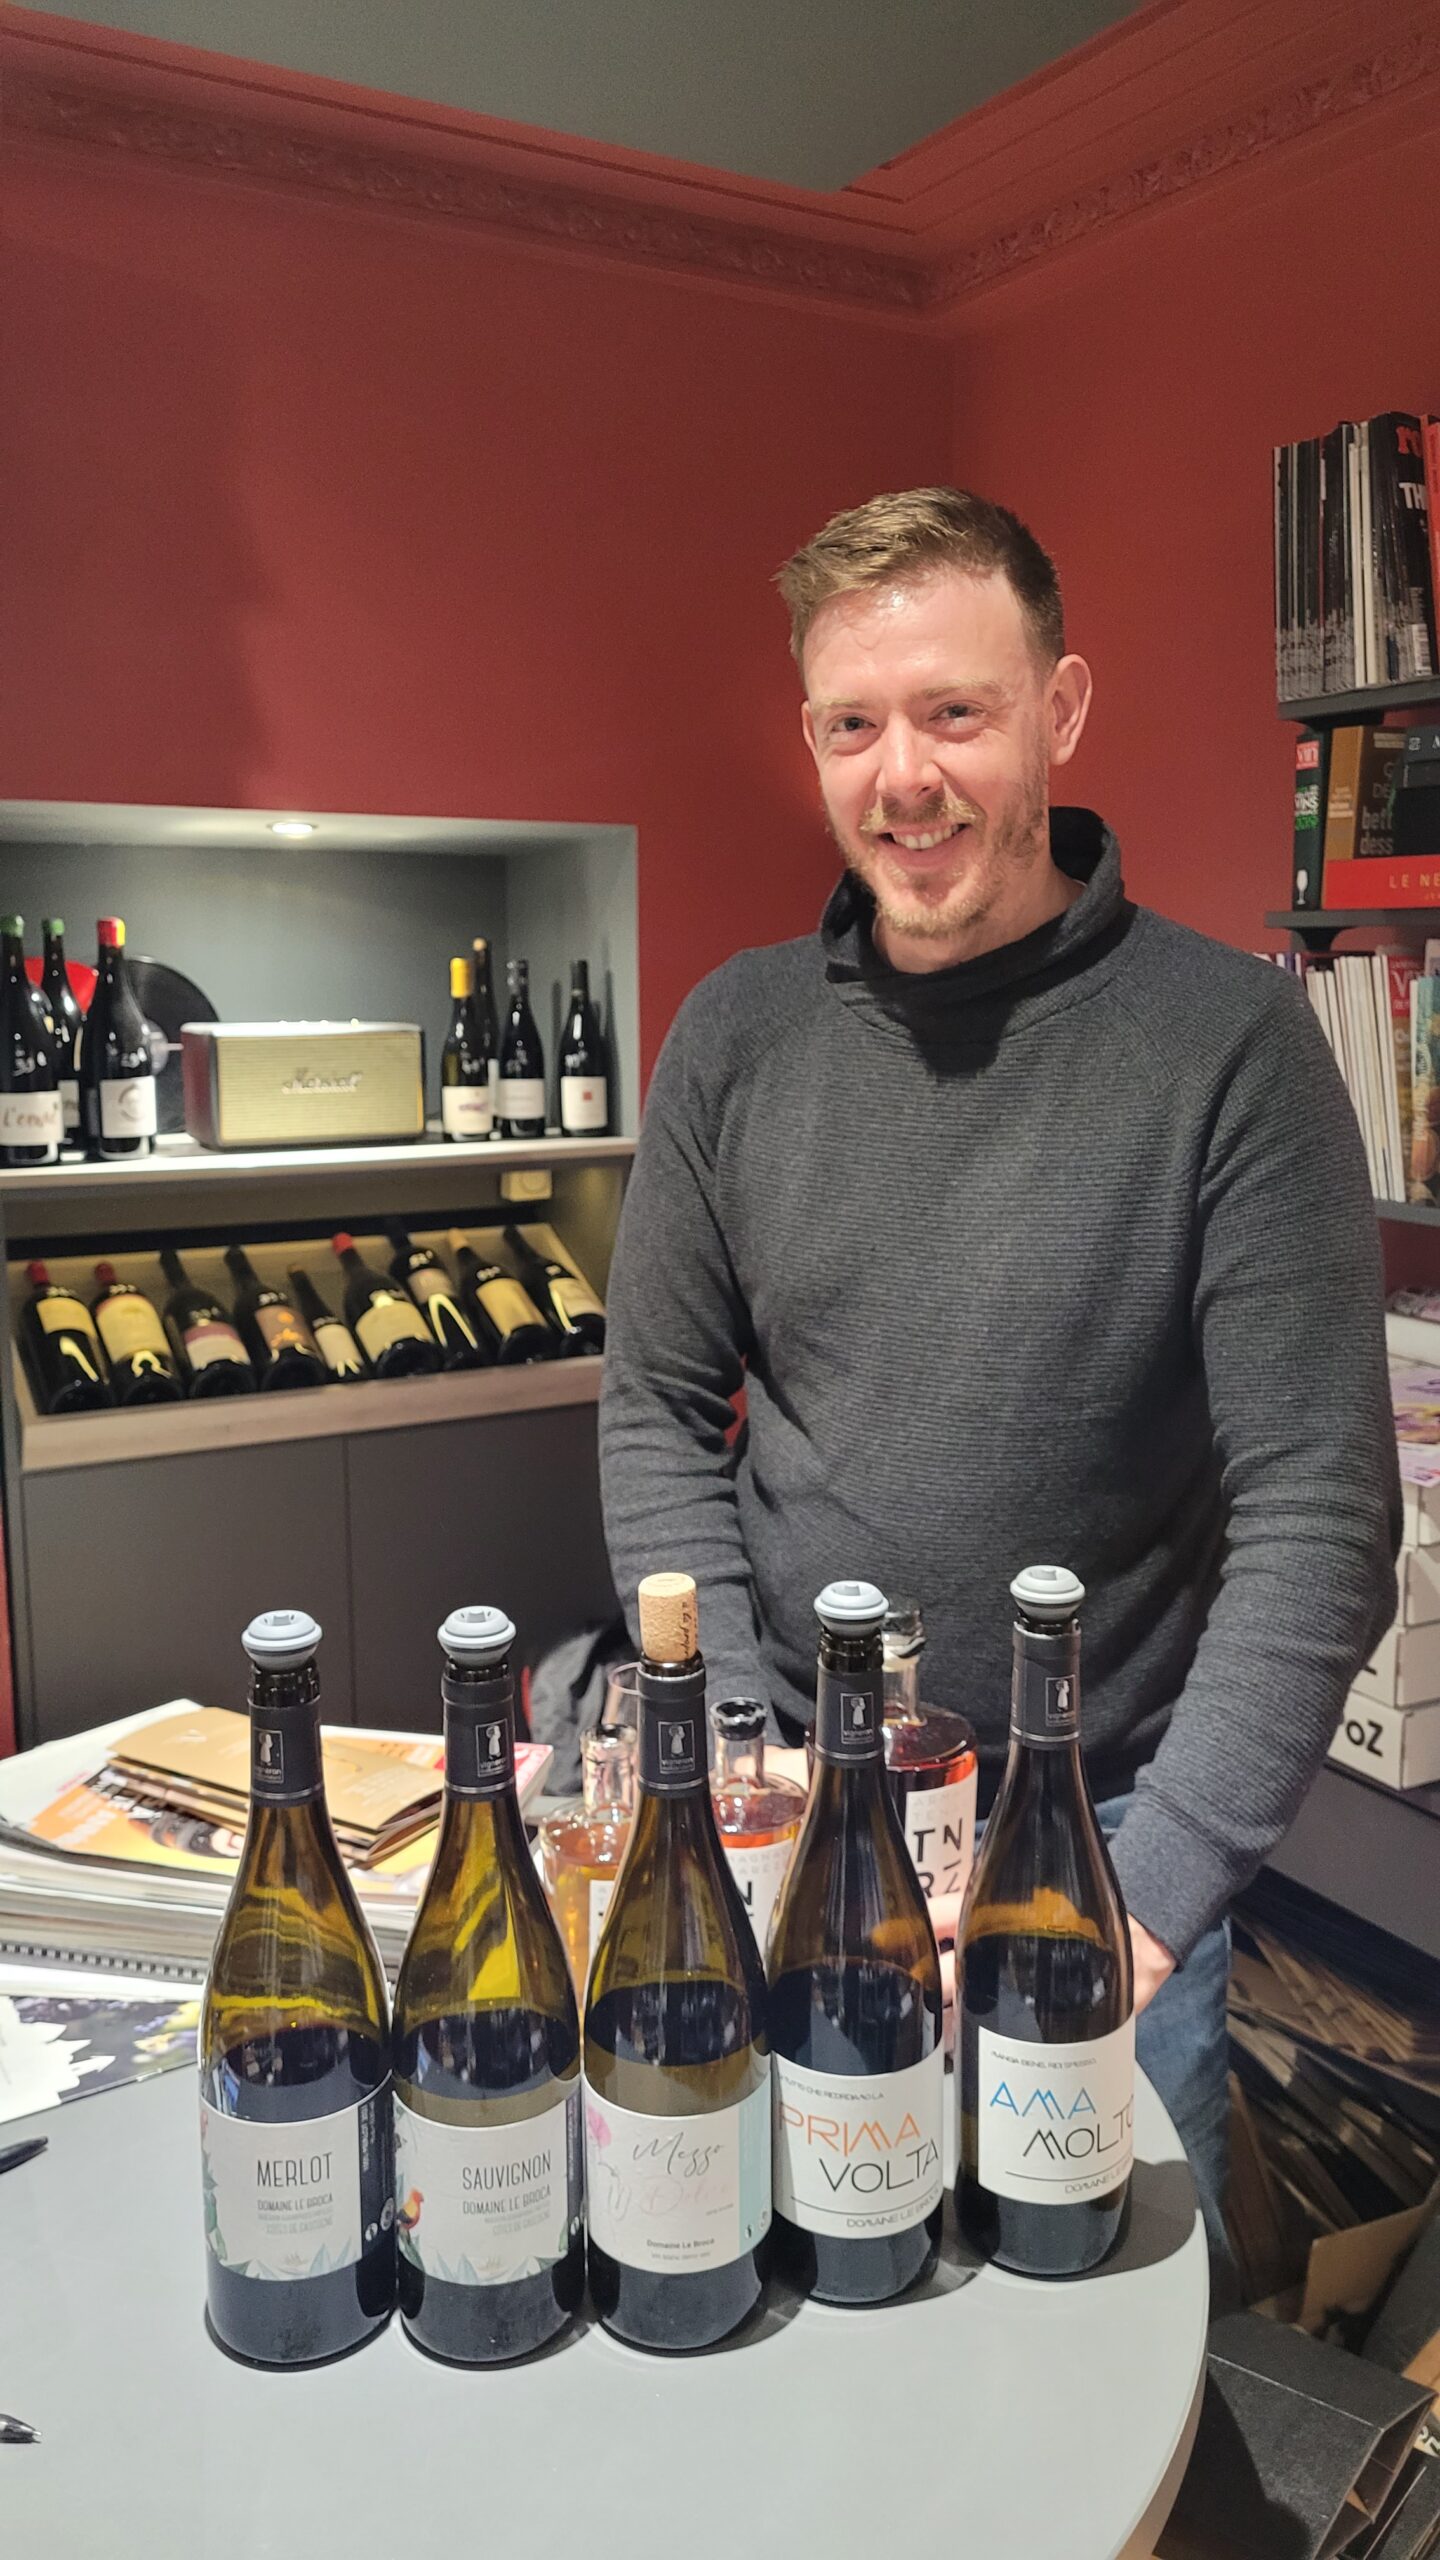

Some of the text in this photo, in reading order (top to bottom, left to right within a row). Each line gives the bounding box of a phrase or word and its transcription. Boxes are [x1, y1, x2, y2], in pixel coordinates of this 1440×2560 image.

[990, 2080, 1097, 2120] AMA
[779, 2101, 921, 2158] PRIMA
[257, 2152, 333, 2188] MERLOT
[462, 2149, 552, 2191] SAUVIGNON
[818, 2138, 940, 2194] VOLTA
[257, 2199, 292, 2212] DOMAINE
[295, 2198, 304, 2211] LE
[463, 2198, 505, 2215] DOMAINE
[509, 2196, 520, 2212] LE
[846, 2212, 897, 2229] DOMAINE
[646, 2239, 681, 2250] Domaine
